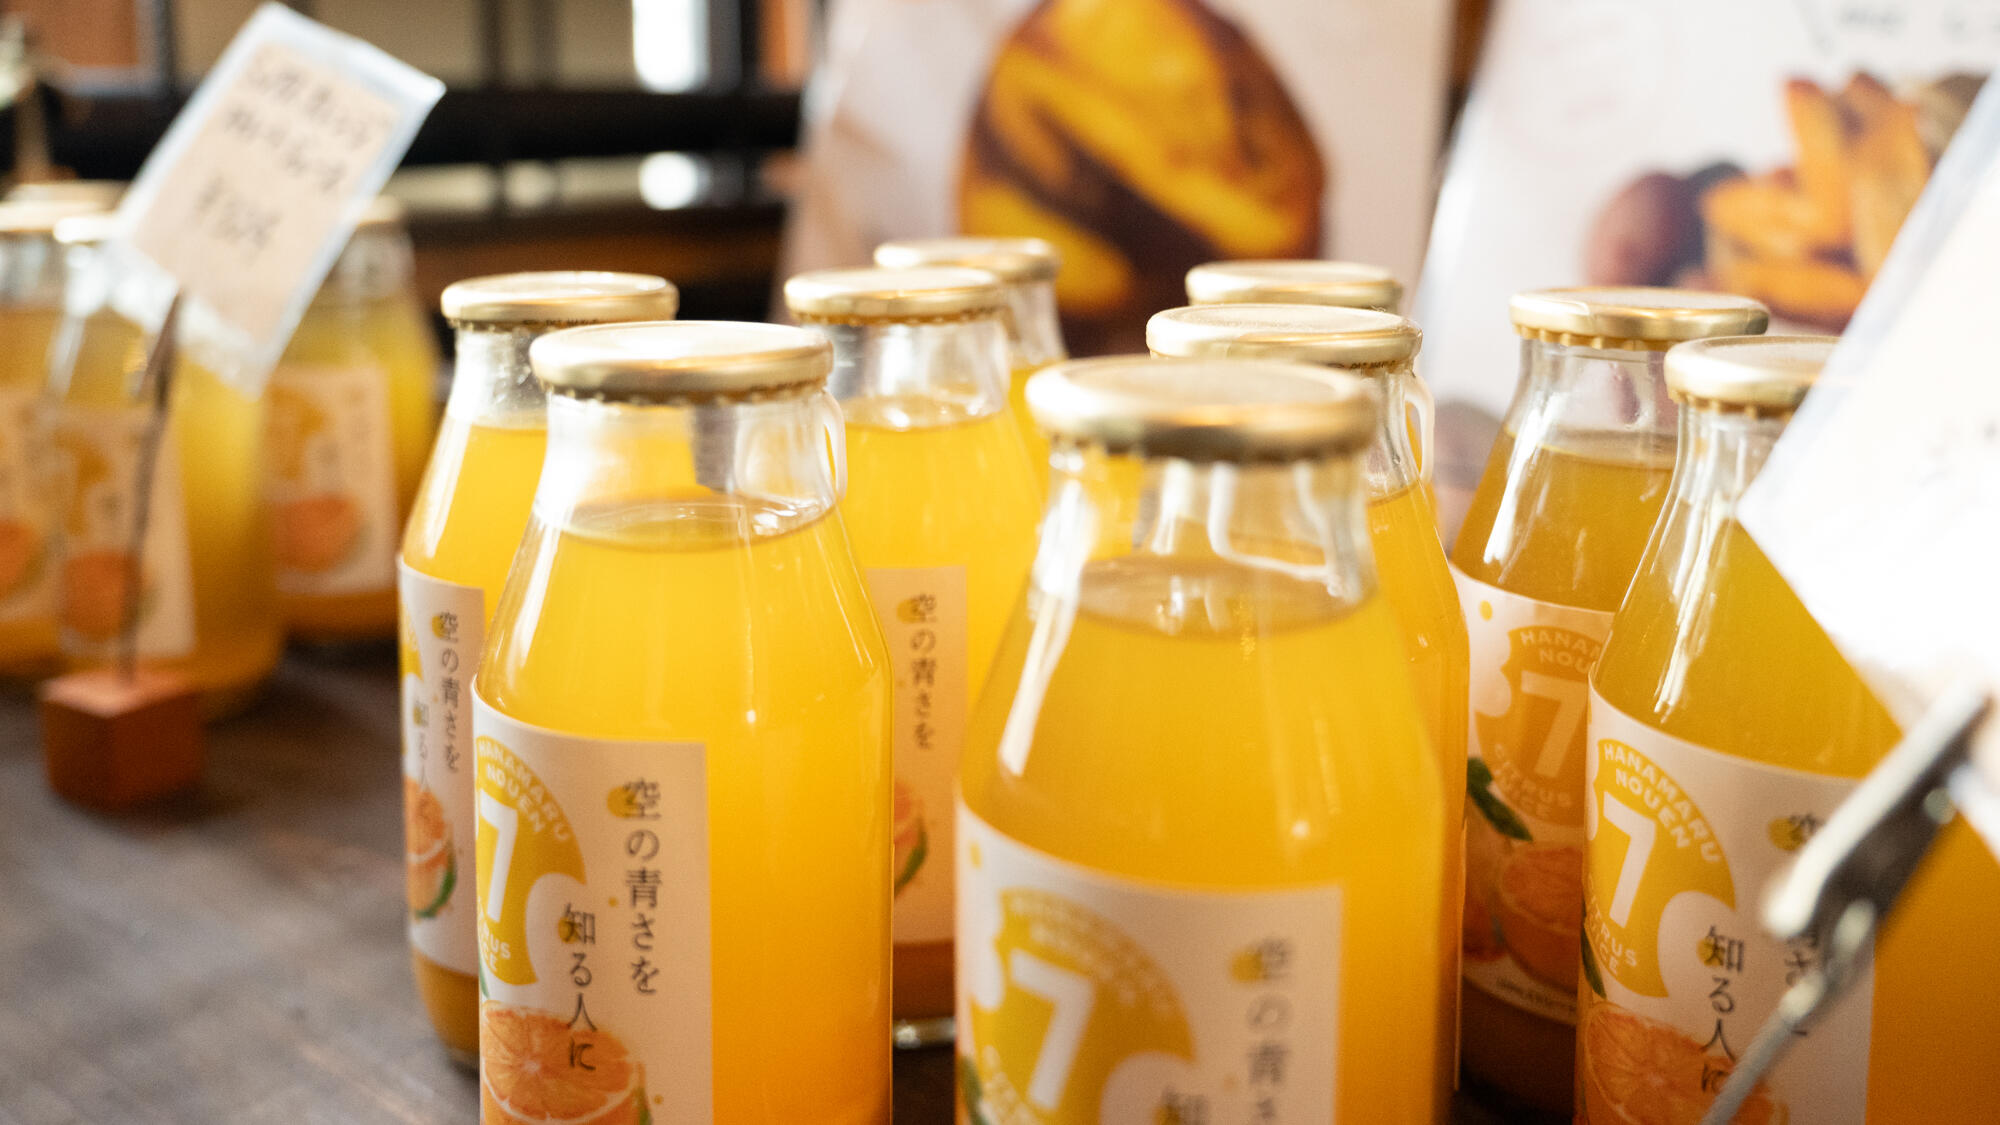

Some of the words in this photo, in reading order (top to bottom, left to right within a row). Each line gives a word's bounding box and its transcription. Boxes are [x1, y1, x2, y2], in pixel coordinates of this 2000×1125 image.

[1521, 670, 1587, 778] 7
[479, 787, 519, 923] 7
[1603, 790, 1657, 928] 7
[1604, 743, 1720, 863] HANAMARU
[1615, 767, 1690, 848] NOUEN
[622, 777, 663, 996] 空の青さを
[563, 902, 598, 1071] 知る人に
[1009, 948, 1094, 1112] 7
